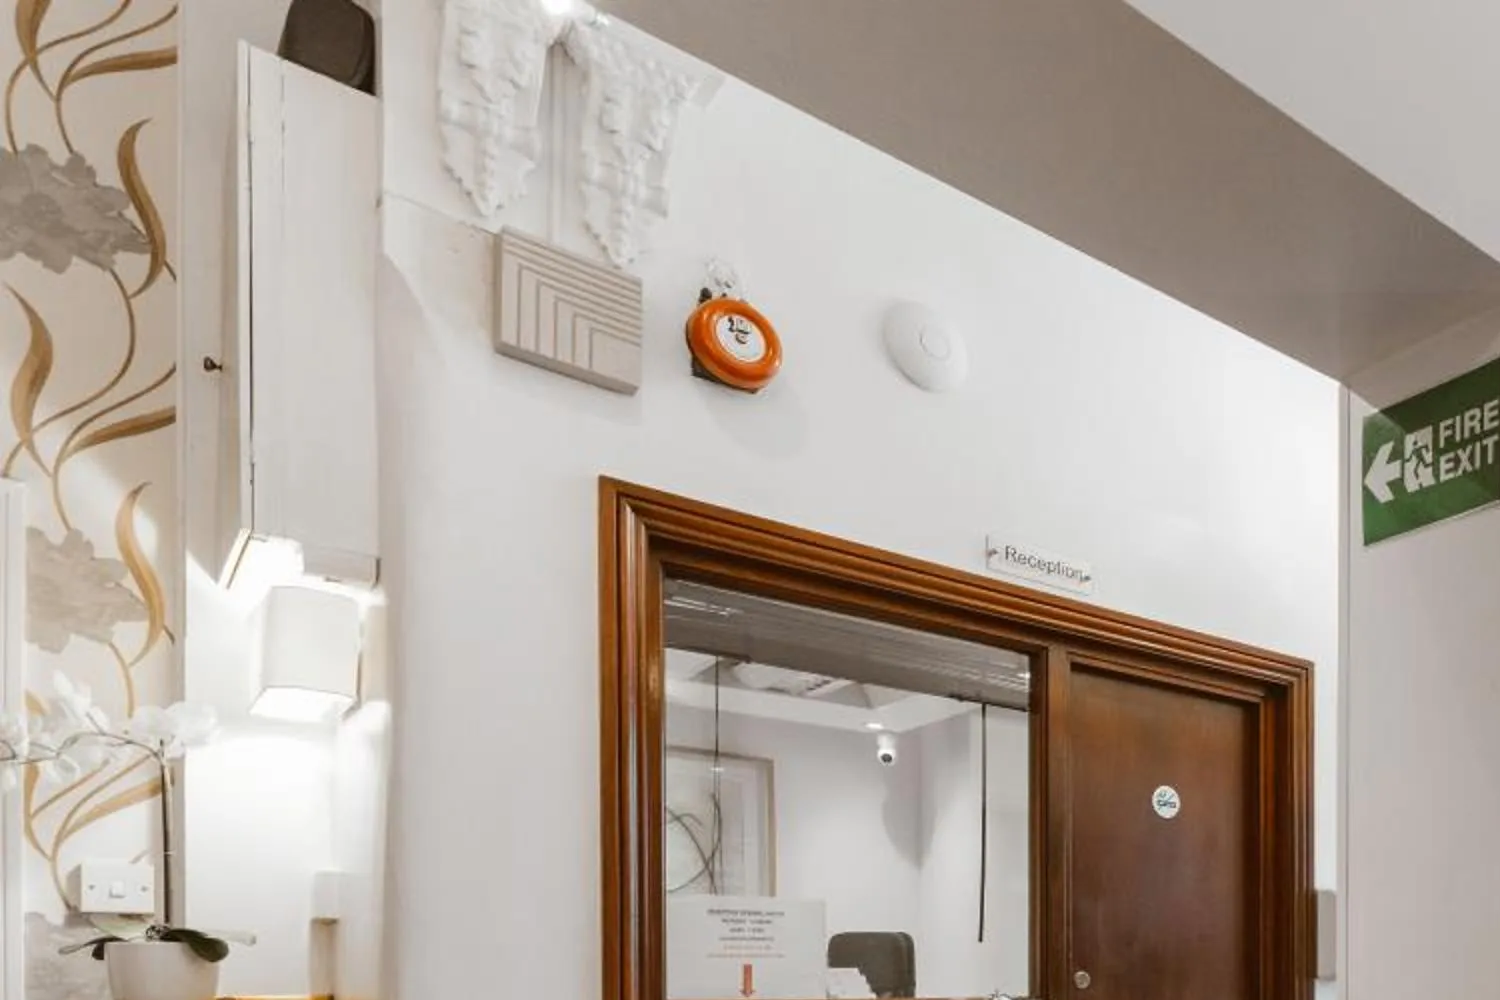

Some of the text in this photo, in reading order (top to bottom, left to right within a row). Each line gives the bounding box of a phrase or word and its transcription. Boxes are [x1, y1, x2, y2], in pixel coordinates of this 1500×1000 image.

[1439, 399, 1500, 449] FIRE
[1439, 434, 1500, 484] EXIT
[1004, 544, 1084, 582] Reception
